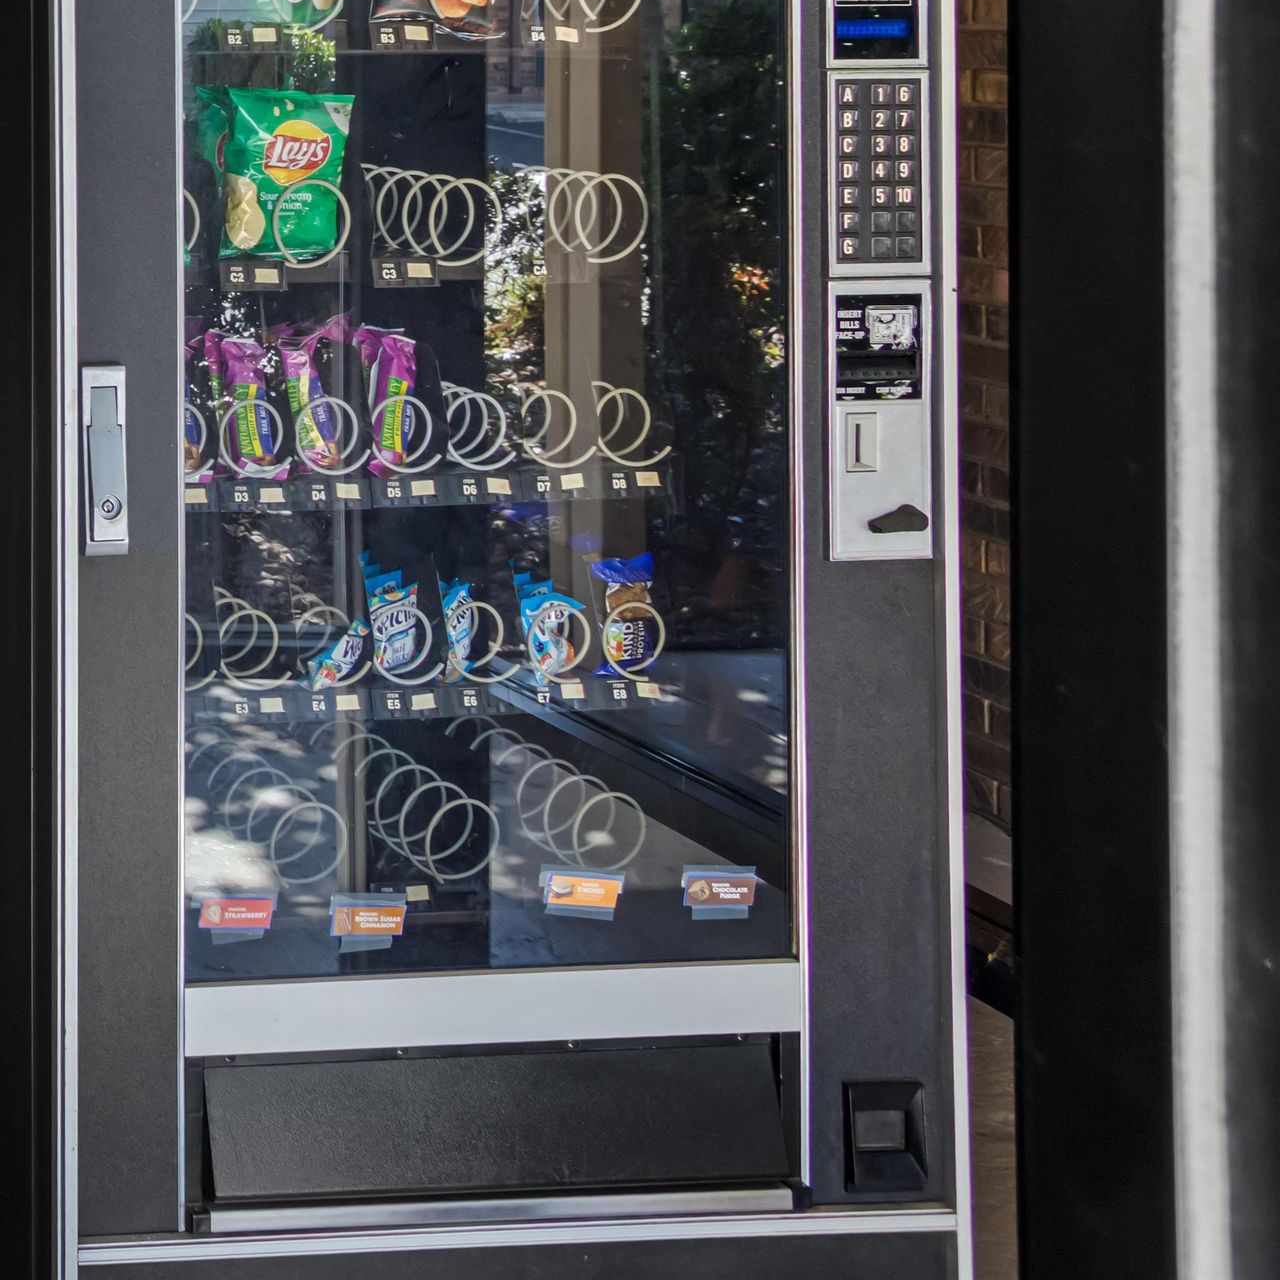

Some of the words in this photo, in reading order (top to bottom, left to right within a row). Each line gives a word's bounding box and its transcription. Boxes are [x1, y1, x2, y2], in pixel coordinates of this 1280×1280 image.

[227, 35, 242, 44] B2
[381, 34, 395, 44] B3
[531, 32, 546, 41] B4
[843, 87, 853, 102] A
[877, 87, 884, 102] 1
[899, 87, 908, 102] 6
[843, 113, 852, 128] B
[875, 112, 884, 127] 2
[899, 112, 908, 127] 7
[843, 138, 853, 153] C
[875, 138, 884, 152] 3
[899, 138, 908, 152] 8
[268, 136, 328, 170] Lay's
[843, 163, 853, 178] D
[875, 163, 884, 178] 4
[899, 163, 908, 178] 9
[260, 192, 279, 200] Sour
[281, 192, 312, 202] ream
[843, 189, 852, 204] E
[875, 188, 884, 203] 5
[897, 188, 911, 203] 10
[267, 201, 273, 210] &
[843, 214, 852, 229] F
[843, 240, 853, 255] G
[382, 269, 396, 279] C3
[533, 266, 547, 275] C4
[230, 273, 244, 282] C2
[837, 310, 862, 318] INSERT
[840, 321, 860, 329] BILLS
[835, 331, 865, 339] FACE-UP
[537, 482, 551, 492] D7
[612, 479, 626, 489] D8
[387, 488, 401, 497] D5
[463, 485, 477, 495] D6
[234, 492, 248, 502] D3
[312, 491, 326, 500] D4
[622, 622, 634, 660] KIND
[537, 693, 550, 703] E7
[613, 690, 627, 699] E8
[312, 701, 326, 711] E4
[387, 699, 400, 709] E5
[463, 696, 477, 706] E6
[235, 704, 249, 713] E3
[224, 911, 267, 919] STRAWBERRY
